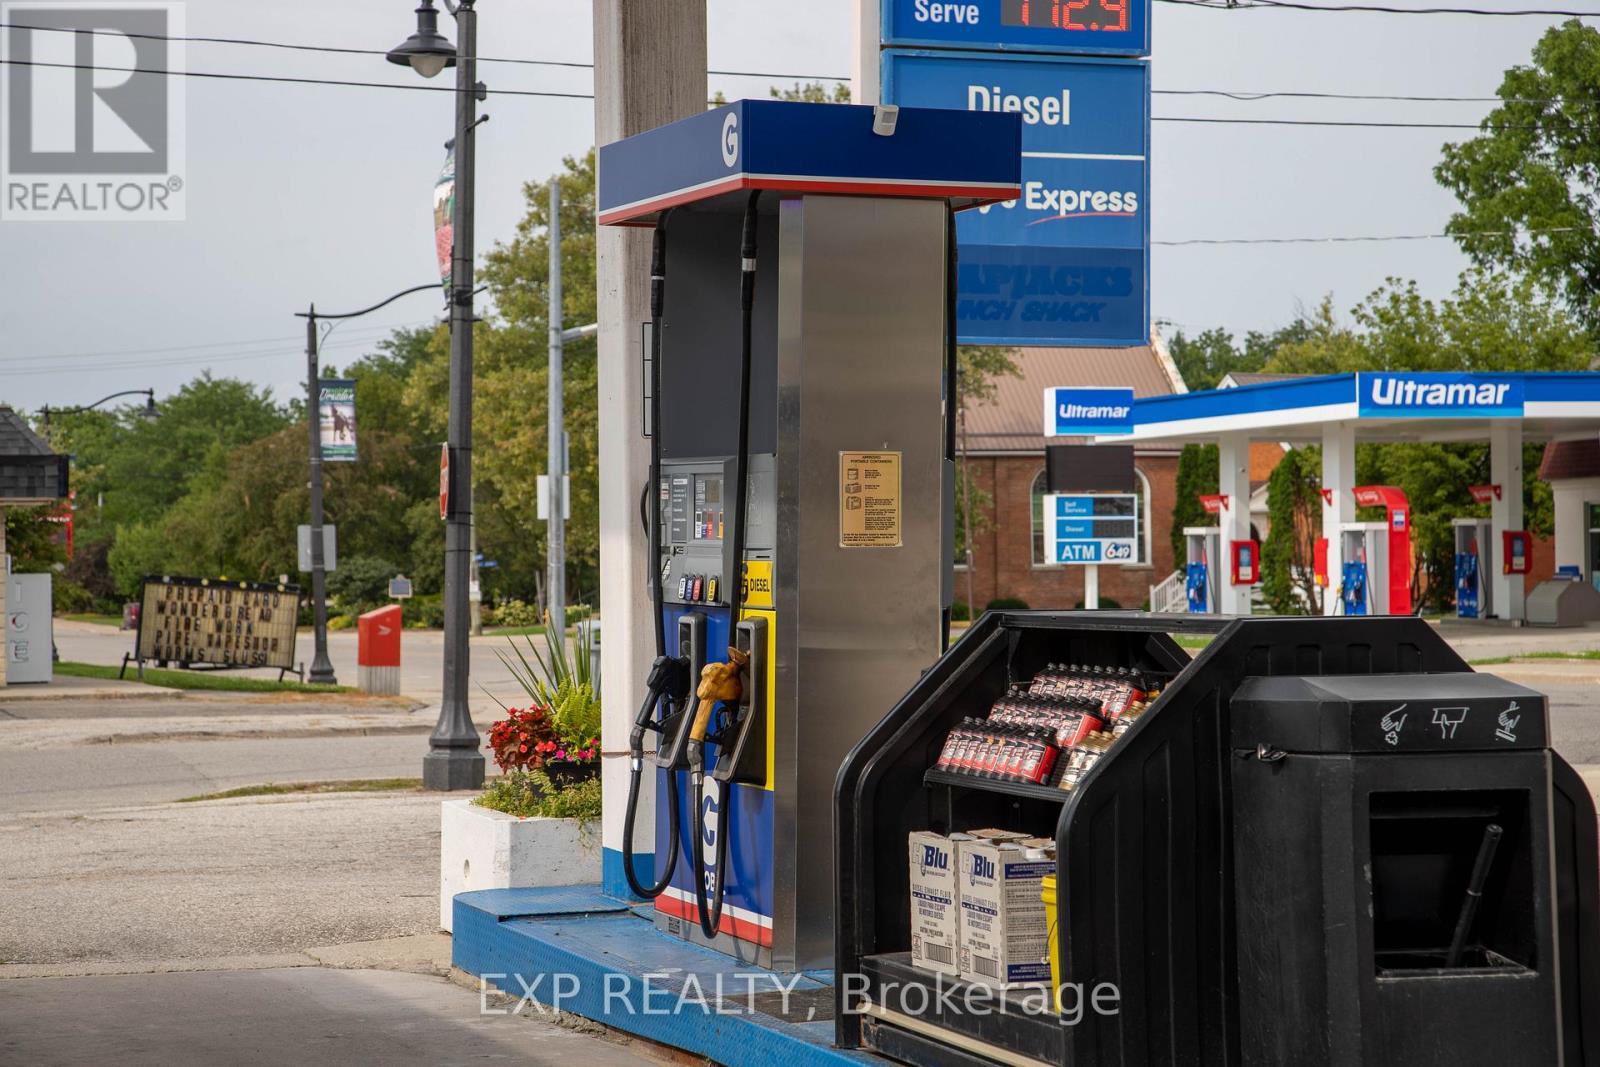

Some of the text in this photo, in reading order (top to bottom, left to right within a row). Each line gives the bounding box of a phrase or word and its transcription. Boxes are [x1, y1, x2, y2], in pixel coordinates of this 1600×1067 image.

[914, 0, 980, 25] Serve
[1025, 181, 1138, 216] Express
[1371, 377, 1511, 406] Ultramar
[1059, 403, 1131, 419] Ultramar
[1061, 545, 1096, 560] ATM
[750, 578, 770, 592] DIESEL
